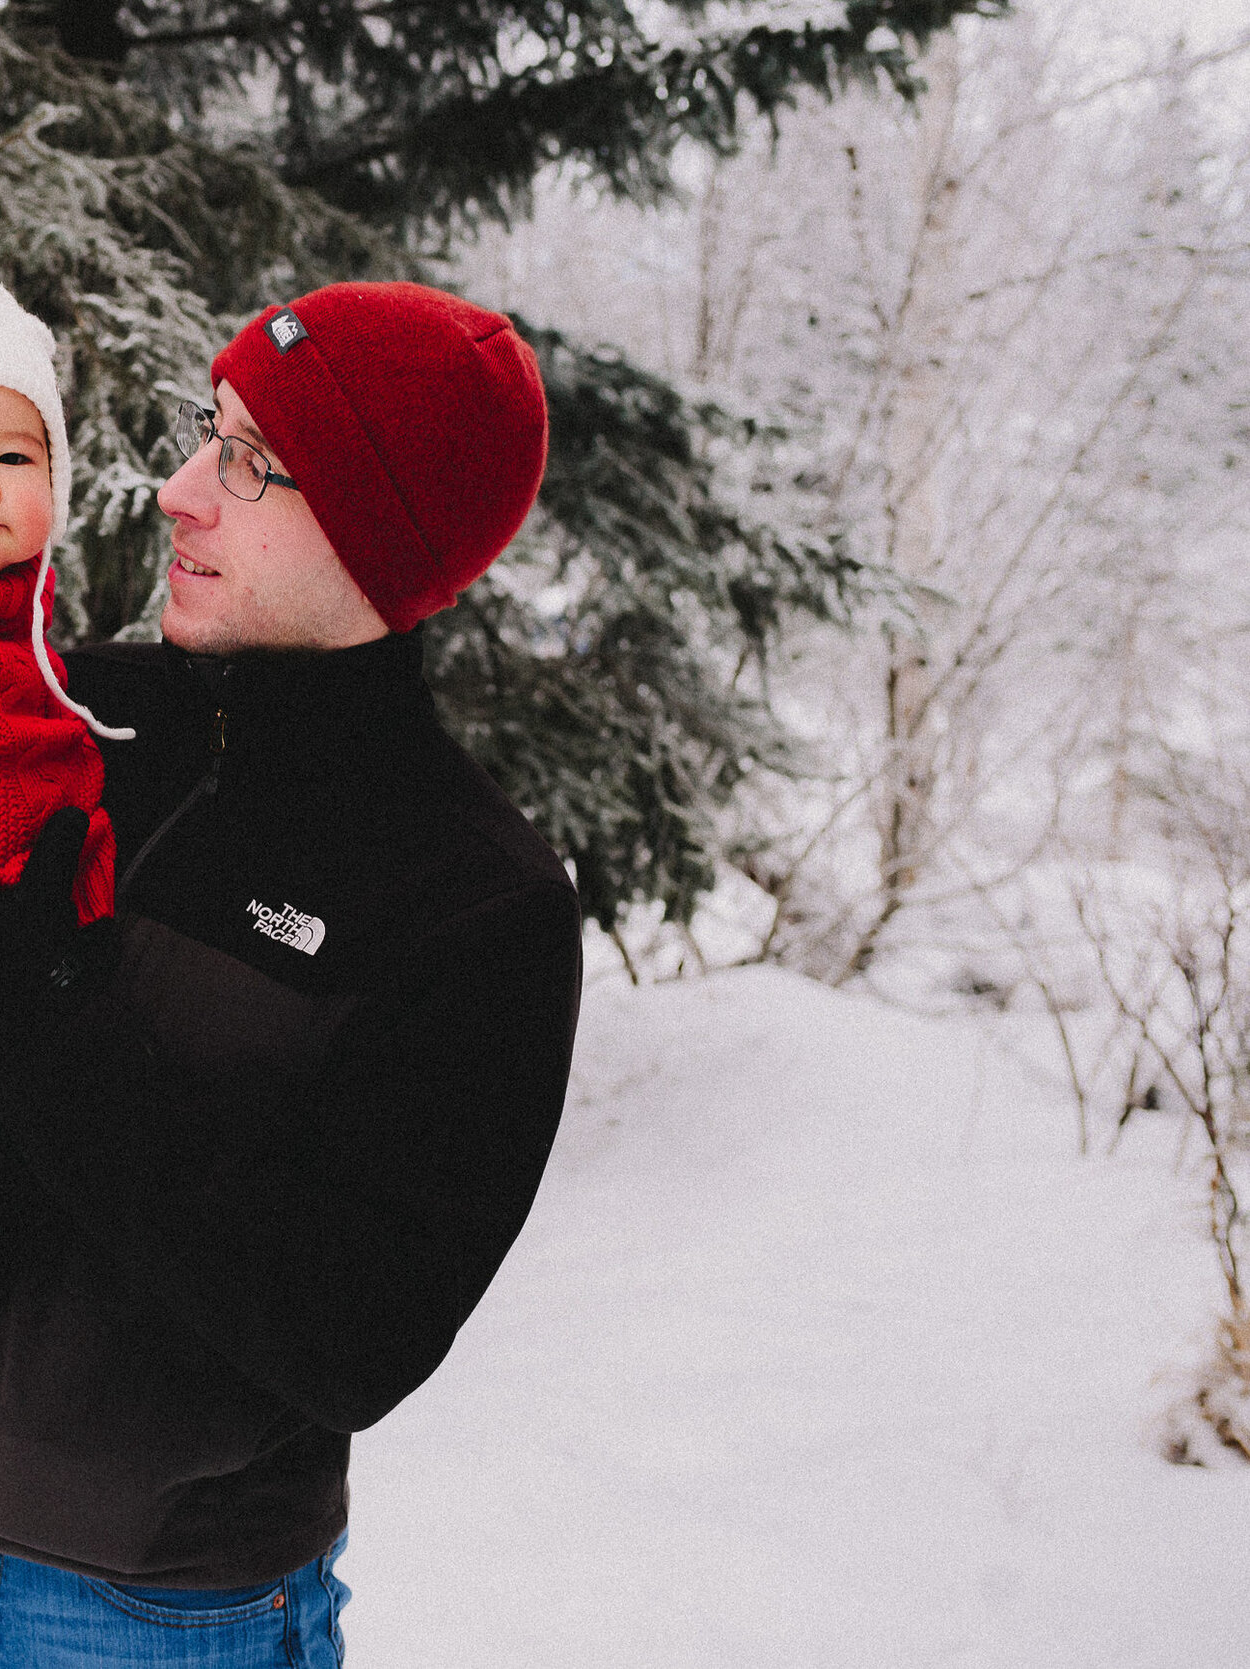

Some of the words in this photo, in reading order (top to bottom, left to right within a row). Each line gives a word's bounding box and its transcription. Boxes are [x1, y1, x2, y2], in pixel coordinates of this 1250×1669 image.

[246, 898, 304, 935] NORTH
[281, 902, 313, 926] THE
[253, 919, 295, 944] FACE
